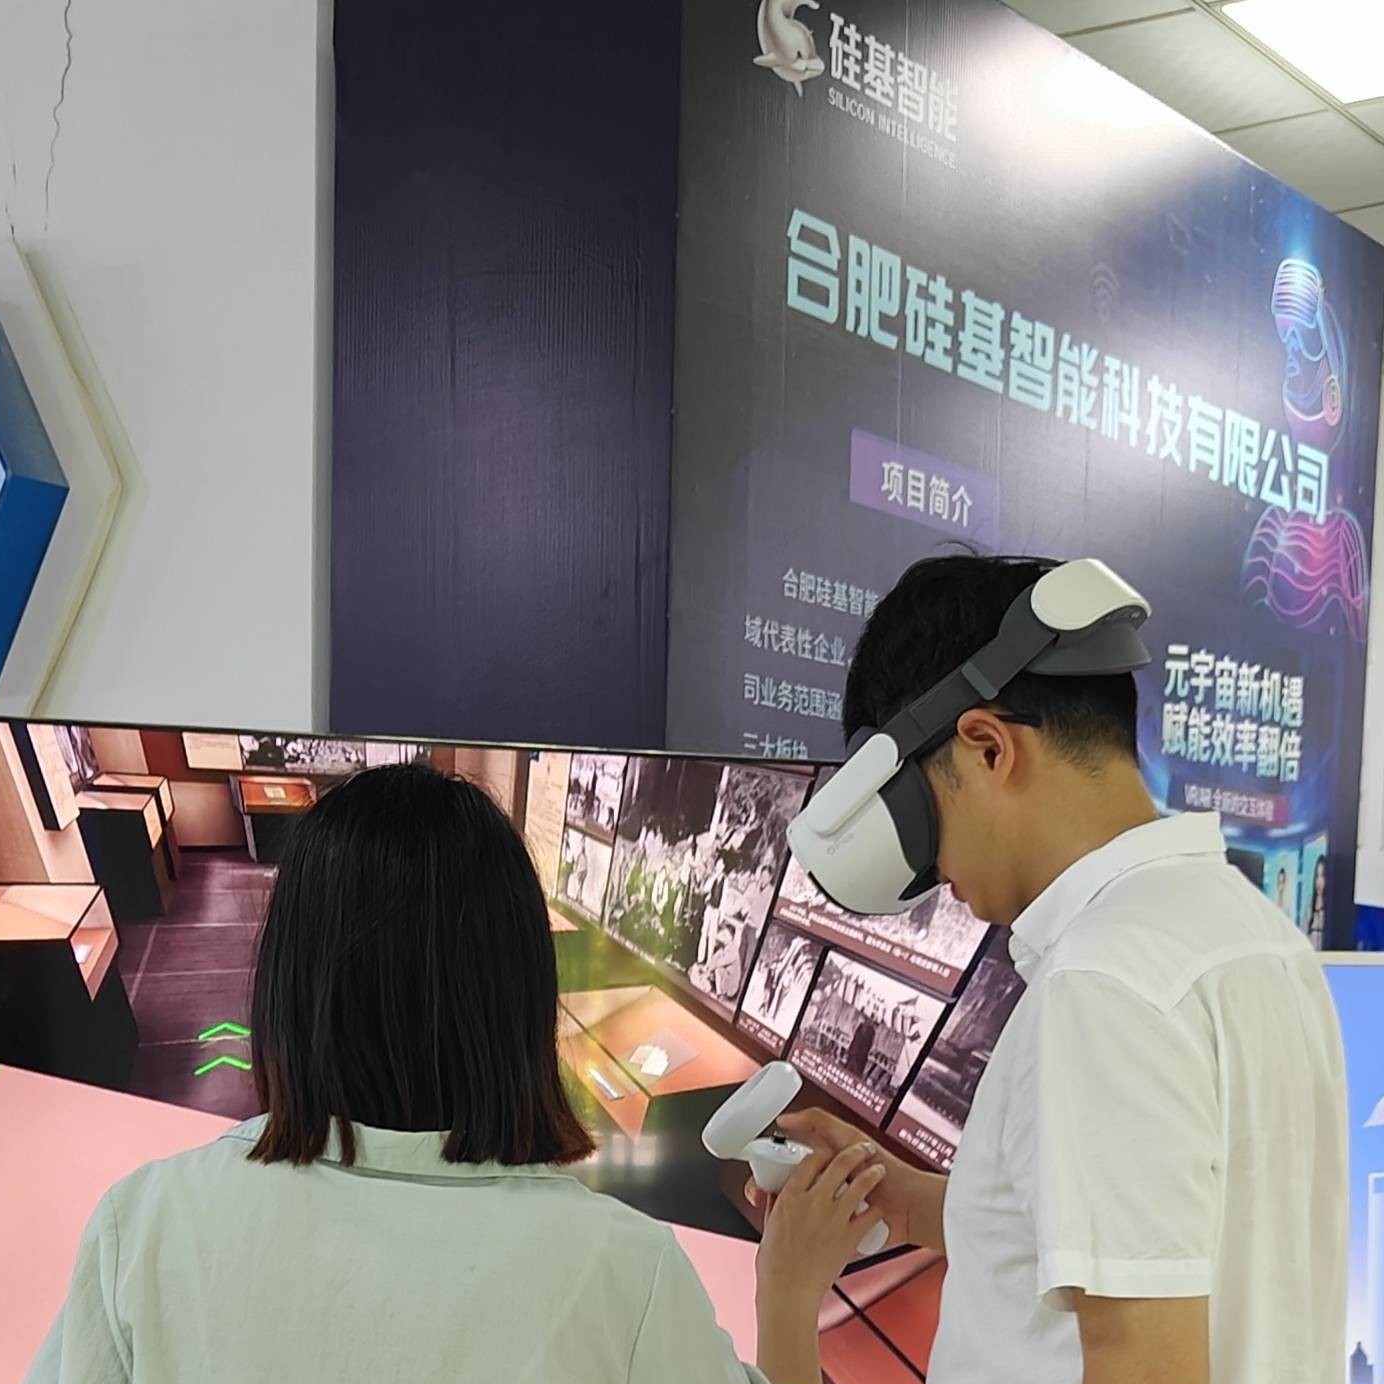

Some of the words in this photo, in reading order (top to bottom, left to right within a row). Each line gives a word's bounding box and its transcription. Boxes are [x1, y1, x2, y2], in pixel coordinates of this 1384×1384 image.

[829, 12, 958, 142] 硅基智能
[827, 86, 875, 126] SILICON
[878, 113, 957, 169] INTELLIGENCE
[786, 208, 1329, 525] 合肥硅基智能科技有限公司
[880, 461, 973, 527] 项目简介
[1164, 644, 1304, 728] 元宇宙新机遇
[1162, 701, 1302, 783] 赋能效率翻倍
